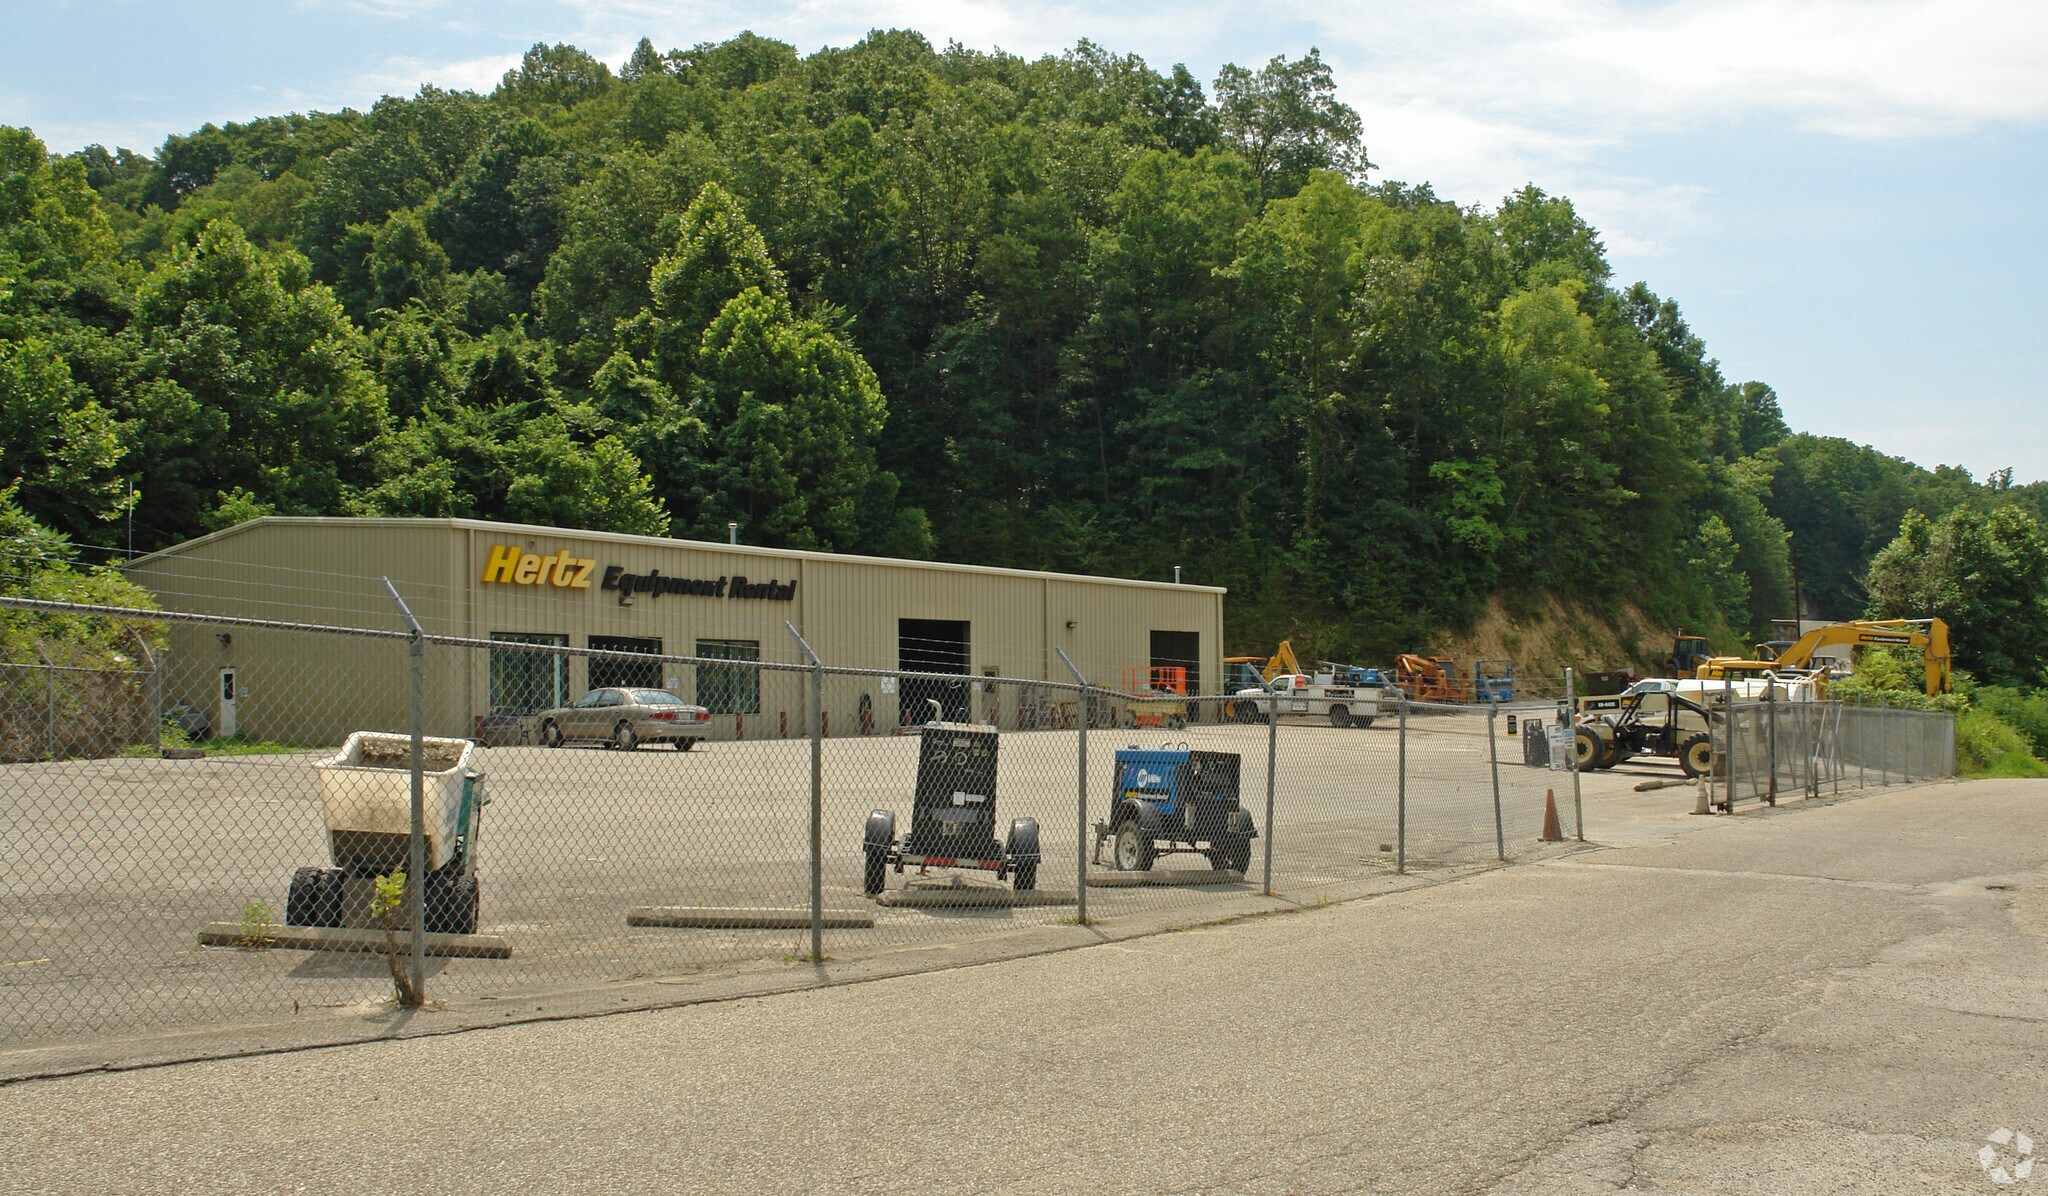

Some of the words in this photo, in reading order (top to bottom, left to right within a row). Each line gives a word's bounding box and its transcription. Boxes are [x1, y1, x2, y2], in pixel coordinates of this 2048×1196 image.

[482, 544, 597, 588] Hertz
[601, 566, 728, 598] Equipment
[728, 576, 797, 600] Rental
